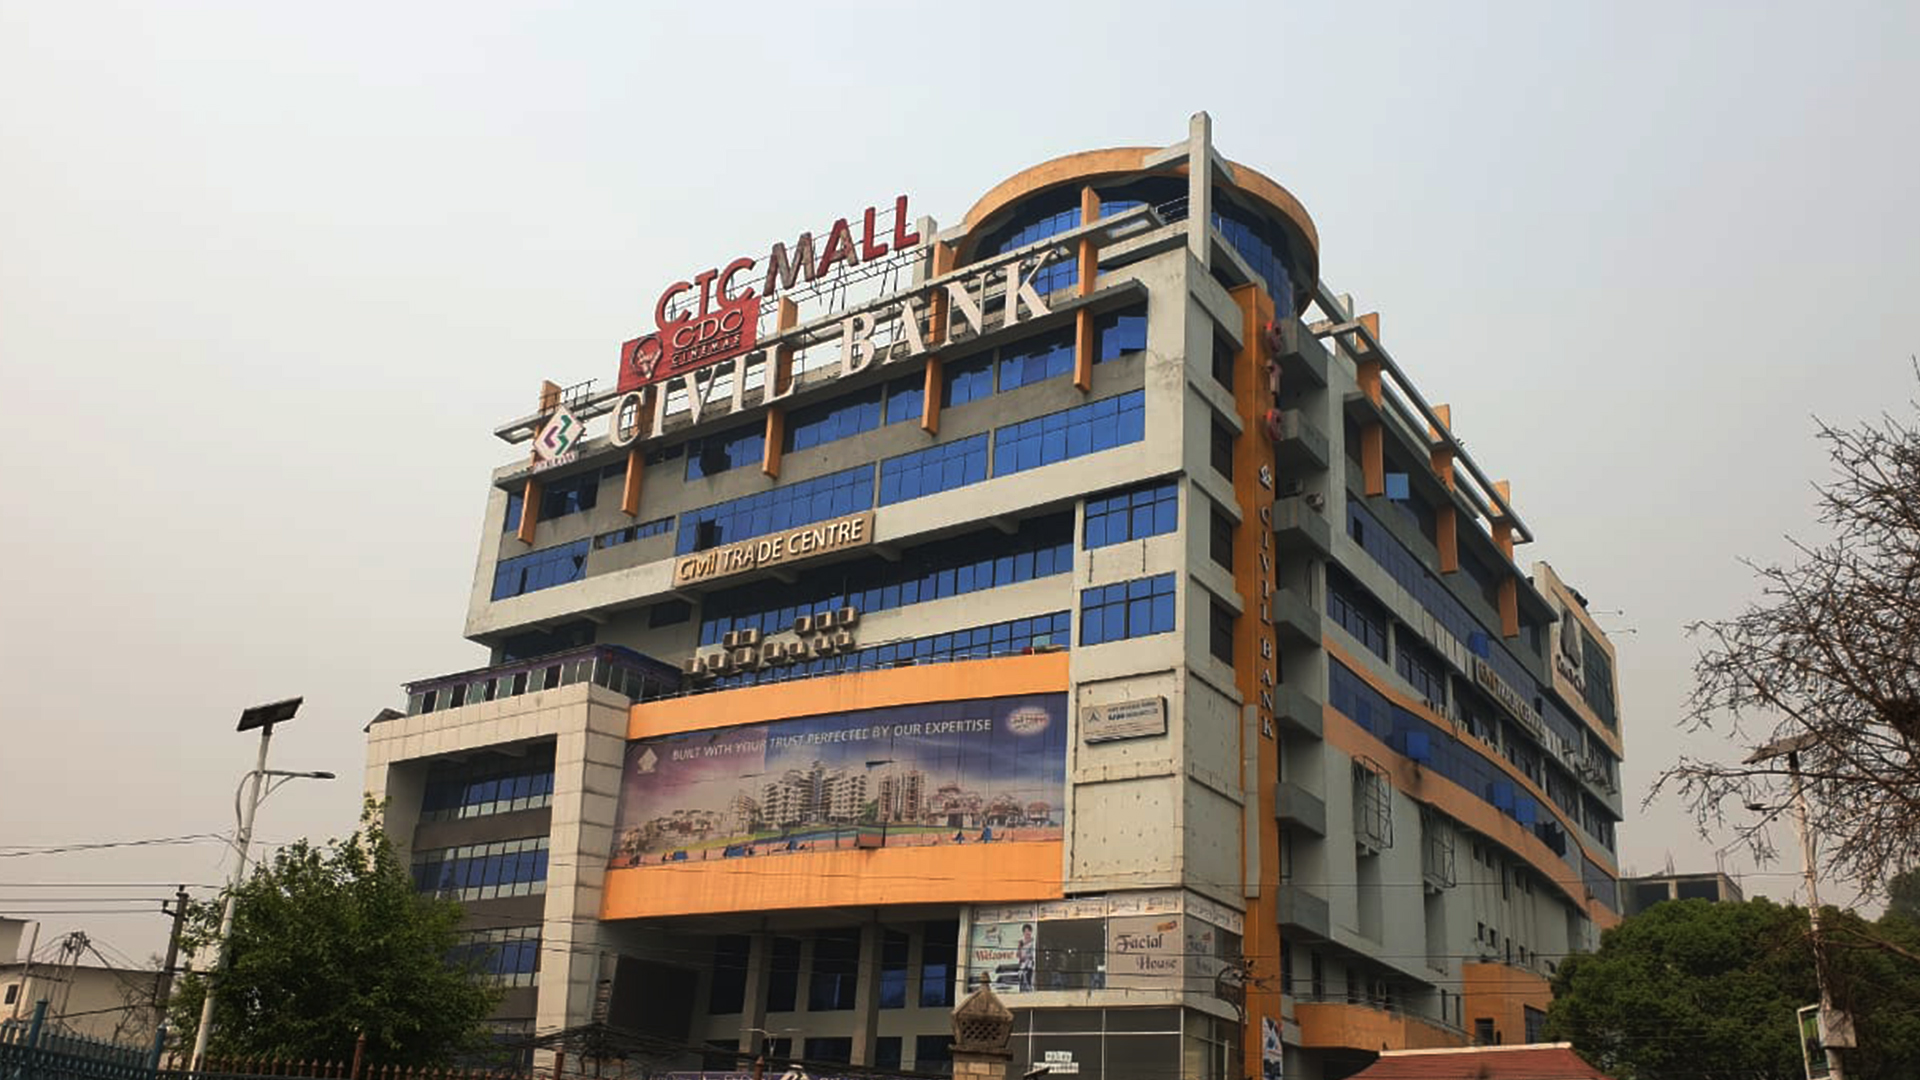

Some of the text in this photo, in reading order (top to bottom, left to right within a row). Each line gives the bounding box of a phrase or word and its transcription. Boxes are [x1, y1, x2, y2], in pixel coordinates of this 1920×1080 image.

[655, 195, 920, 333] CTC MALL
[610, 250, 1053, 447] CIVIL BANK
[724, 537, 784, 572] TRADE
[789, 518, 864, 554] CENTRE
[1259, 505, 1273, 627] CIVIL
[1260, 636, 1273, 742] BANK
[672, 746, 700, 761] BUILT
[703, 744, 733, 757] WITH
[736, 739, 767, 754] YOUR
[770, 734, 804, 749] TRUST
[806, 727, 869, 747] PERFECTED
[872, 725, 890, 738] BY
[893, 722, 922, 737] OUR
[925, 718, 992, 735] EXPERTISE
[1114, 932, 1164, 953] Facial
[1136, 955, 1178, 971] House
